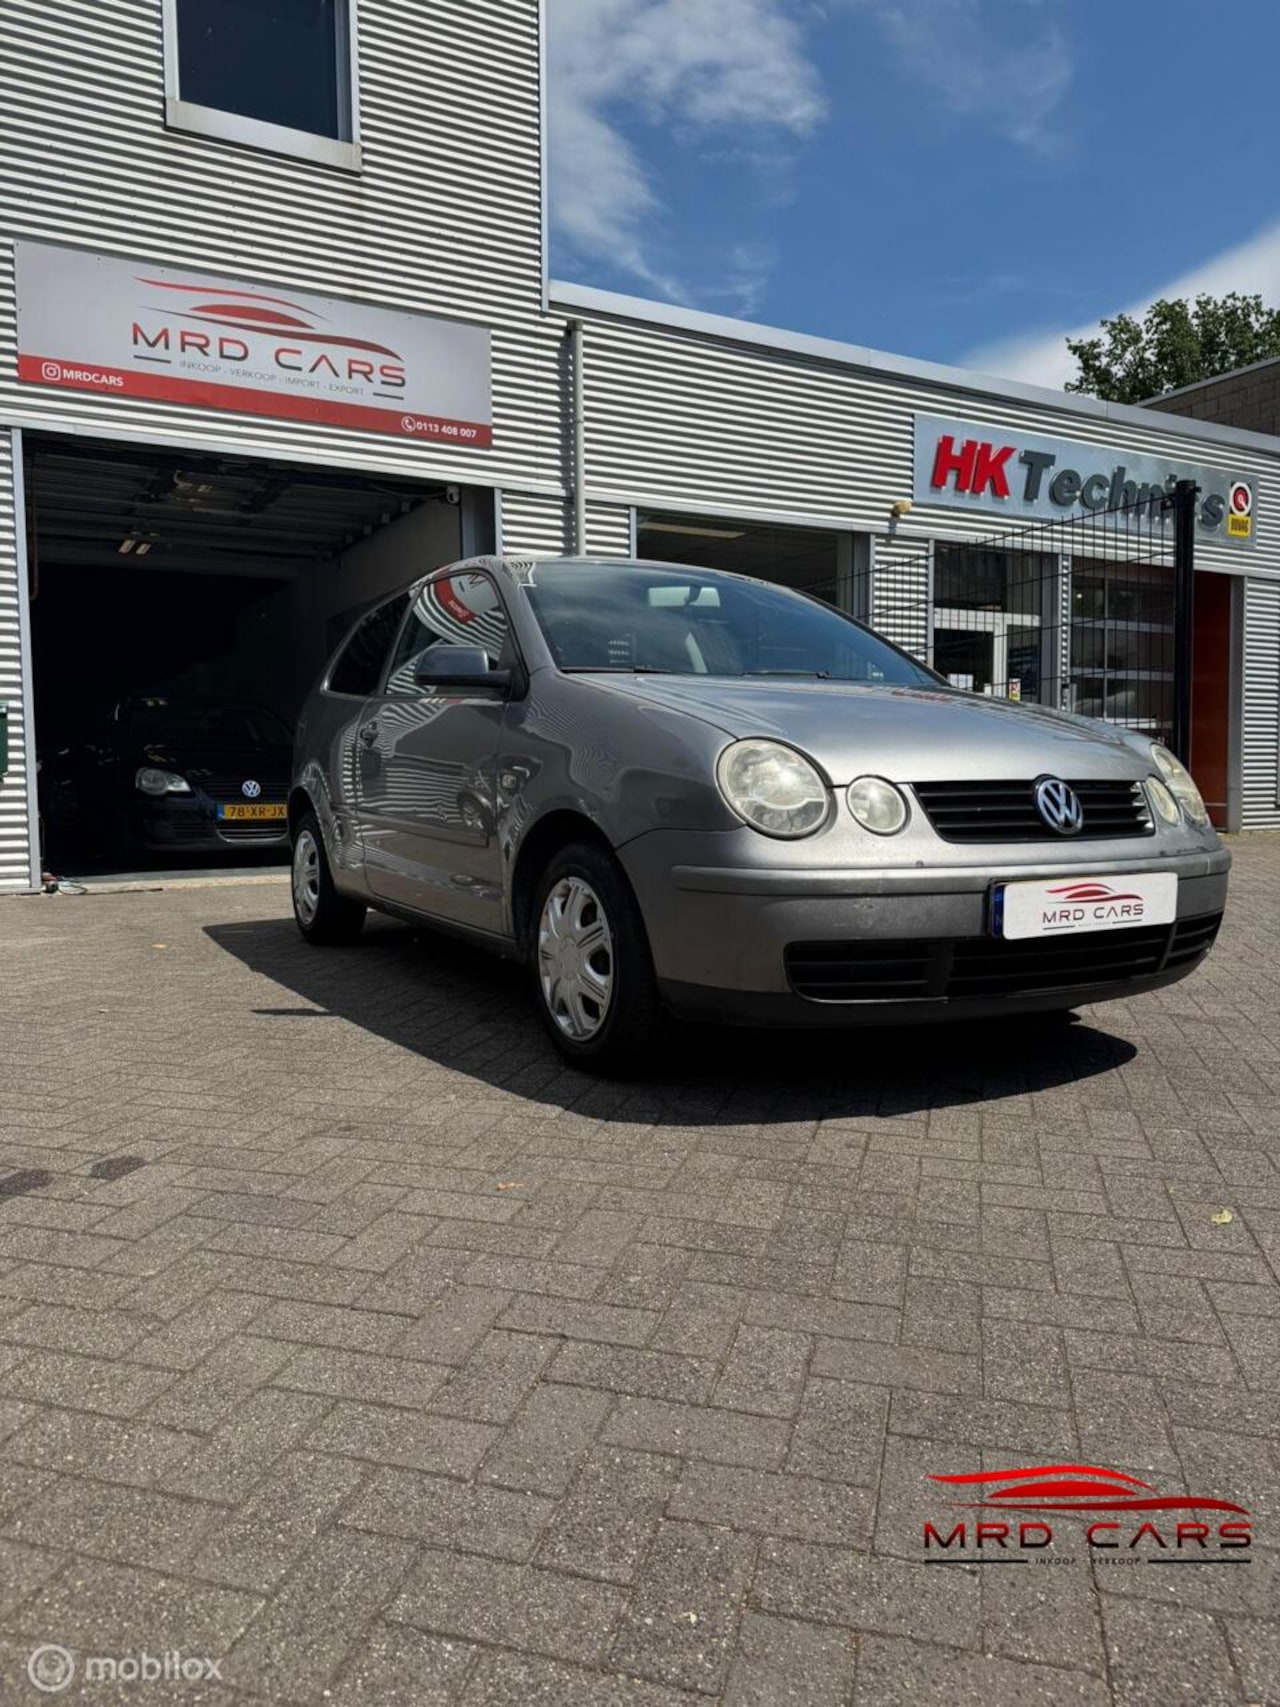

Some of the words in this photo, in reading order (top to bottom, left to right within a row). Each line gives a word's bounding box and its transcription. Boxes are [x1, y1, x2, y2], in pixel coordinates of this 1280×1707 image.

[133, 322, 249, 361] MRD
[274, 347, 406, 387] CARS
[63, 368, 124, 387] MRDCARS
[179, 360, 221, 374] INKOOP
[230, 368, 277, 382] VERKOOP
[285, 376, 320, 389] IMPORT
[329, 383, 364, 396] EXPORT
[416, 421, 439, 433] 0113
[441, 425, 458, 436] 408
[460, 428, 477, 438] 007
[931, 436, 1017, 499] HK
[1019, 450, 1225, 529] Technis
[230, 806, 285, 817] 78-XR-JX
[1042, 909, 1085, 924] MRD
[1093, 903, 1144, 919] CARS
